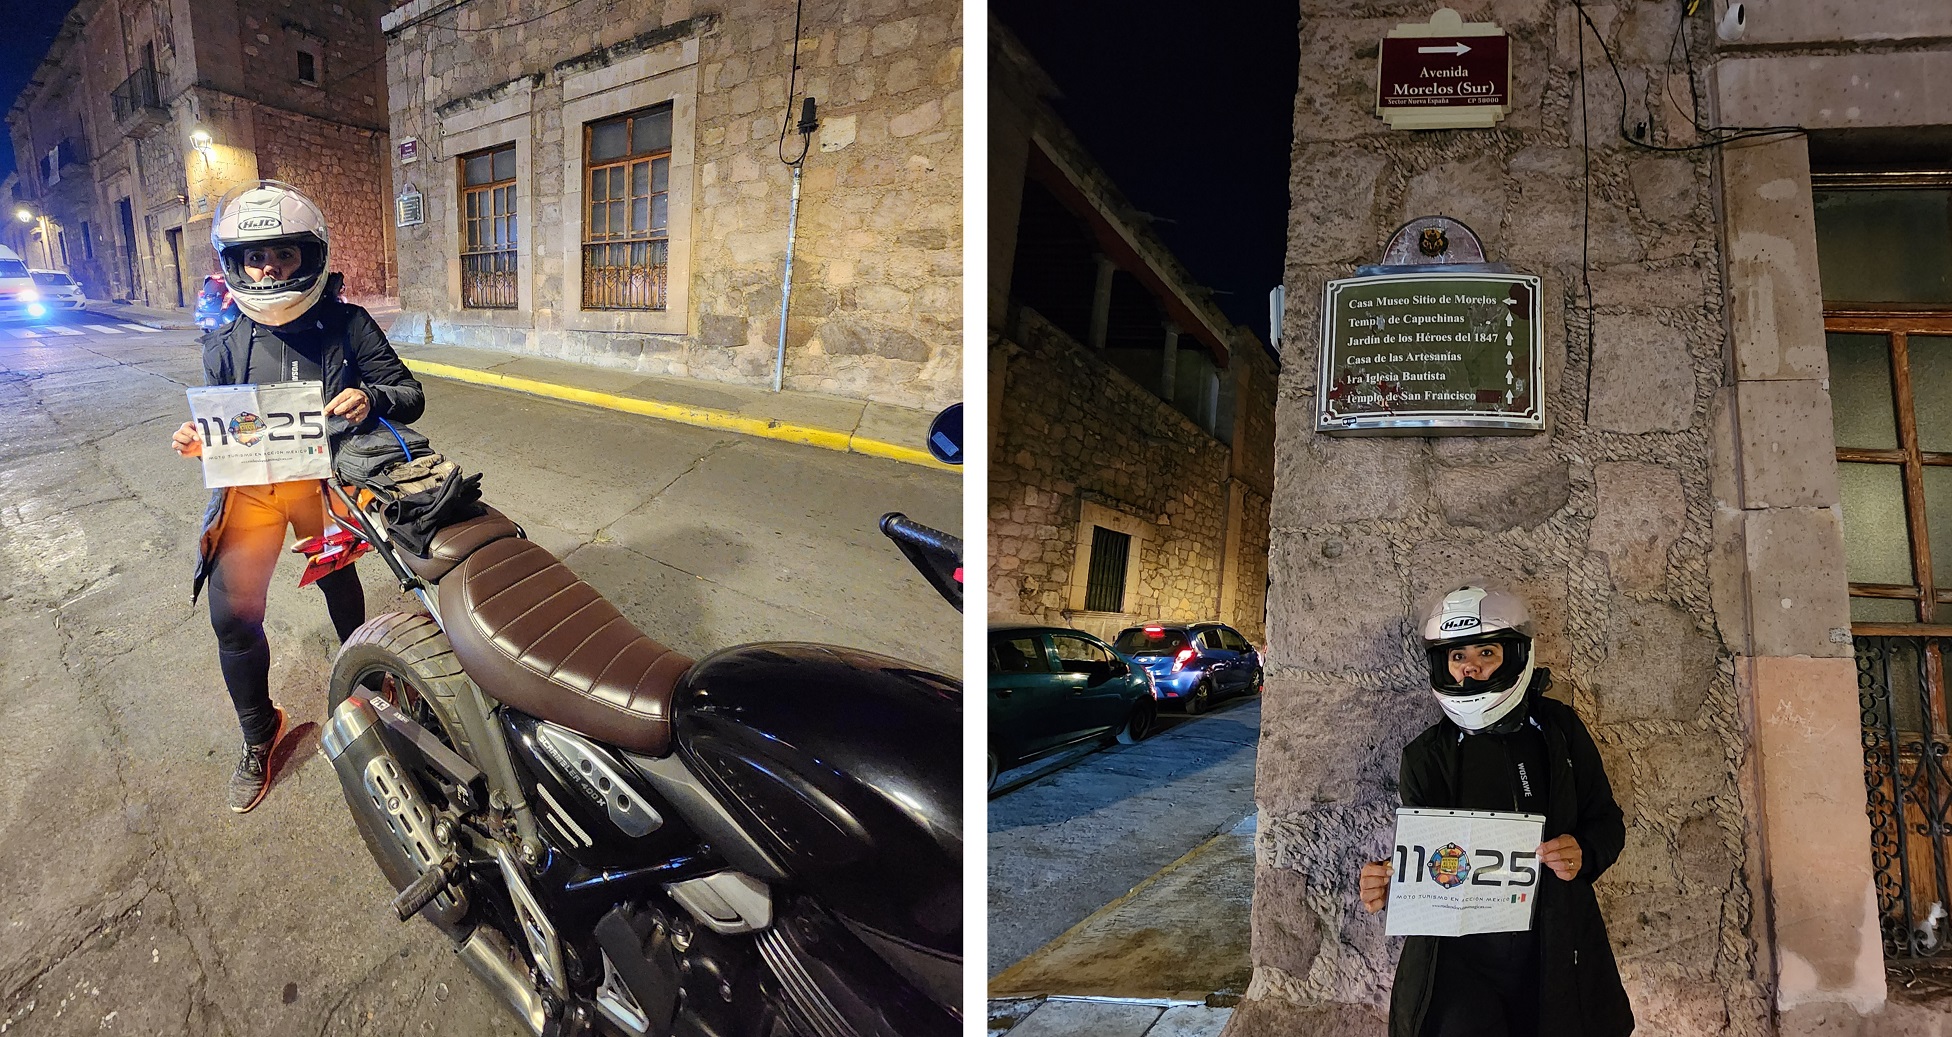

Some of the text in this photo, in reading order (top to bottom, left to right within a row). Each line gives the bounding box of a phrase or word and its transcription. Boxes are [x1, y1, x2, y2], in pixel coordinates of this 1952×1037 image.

[1419, 65, 1469, 78] Avenida
[1393, 80, 1495, 96] Morelos (Sur)
[243, 219, 276, 229] HJC
[1348, 294, 1497, 309] Casa Museo Sitio de Morelos
[1387, 315, 1400, 325] de
[1402, 313, 1465, 326] Capuchinas
[1347, 332, 1499, 347] Jardín de los Héroes del 1847
[1346, 351, 1462, 365] Casa de las Artesanías
[1346, 371, 1446, 385] 1ra Iglesia Bautista
[1385, 391, 1398, 401] de
[1401, 391, 1421, 401] San
[1424, 390, 1477, 401] Francisco
[197, 410, 324, 447] 11 25
[1444, 618, 1476, 630] HJC
[538, 735, 581, 782] SCRAMBLER
[1517, 762, 1533, 798] WOSAWE
[1396, 844, 1537, 887] 11 25
